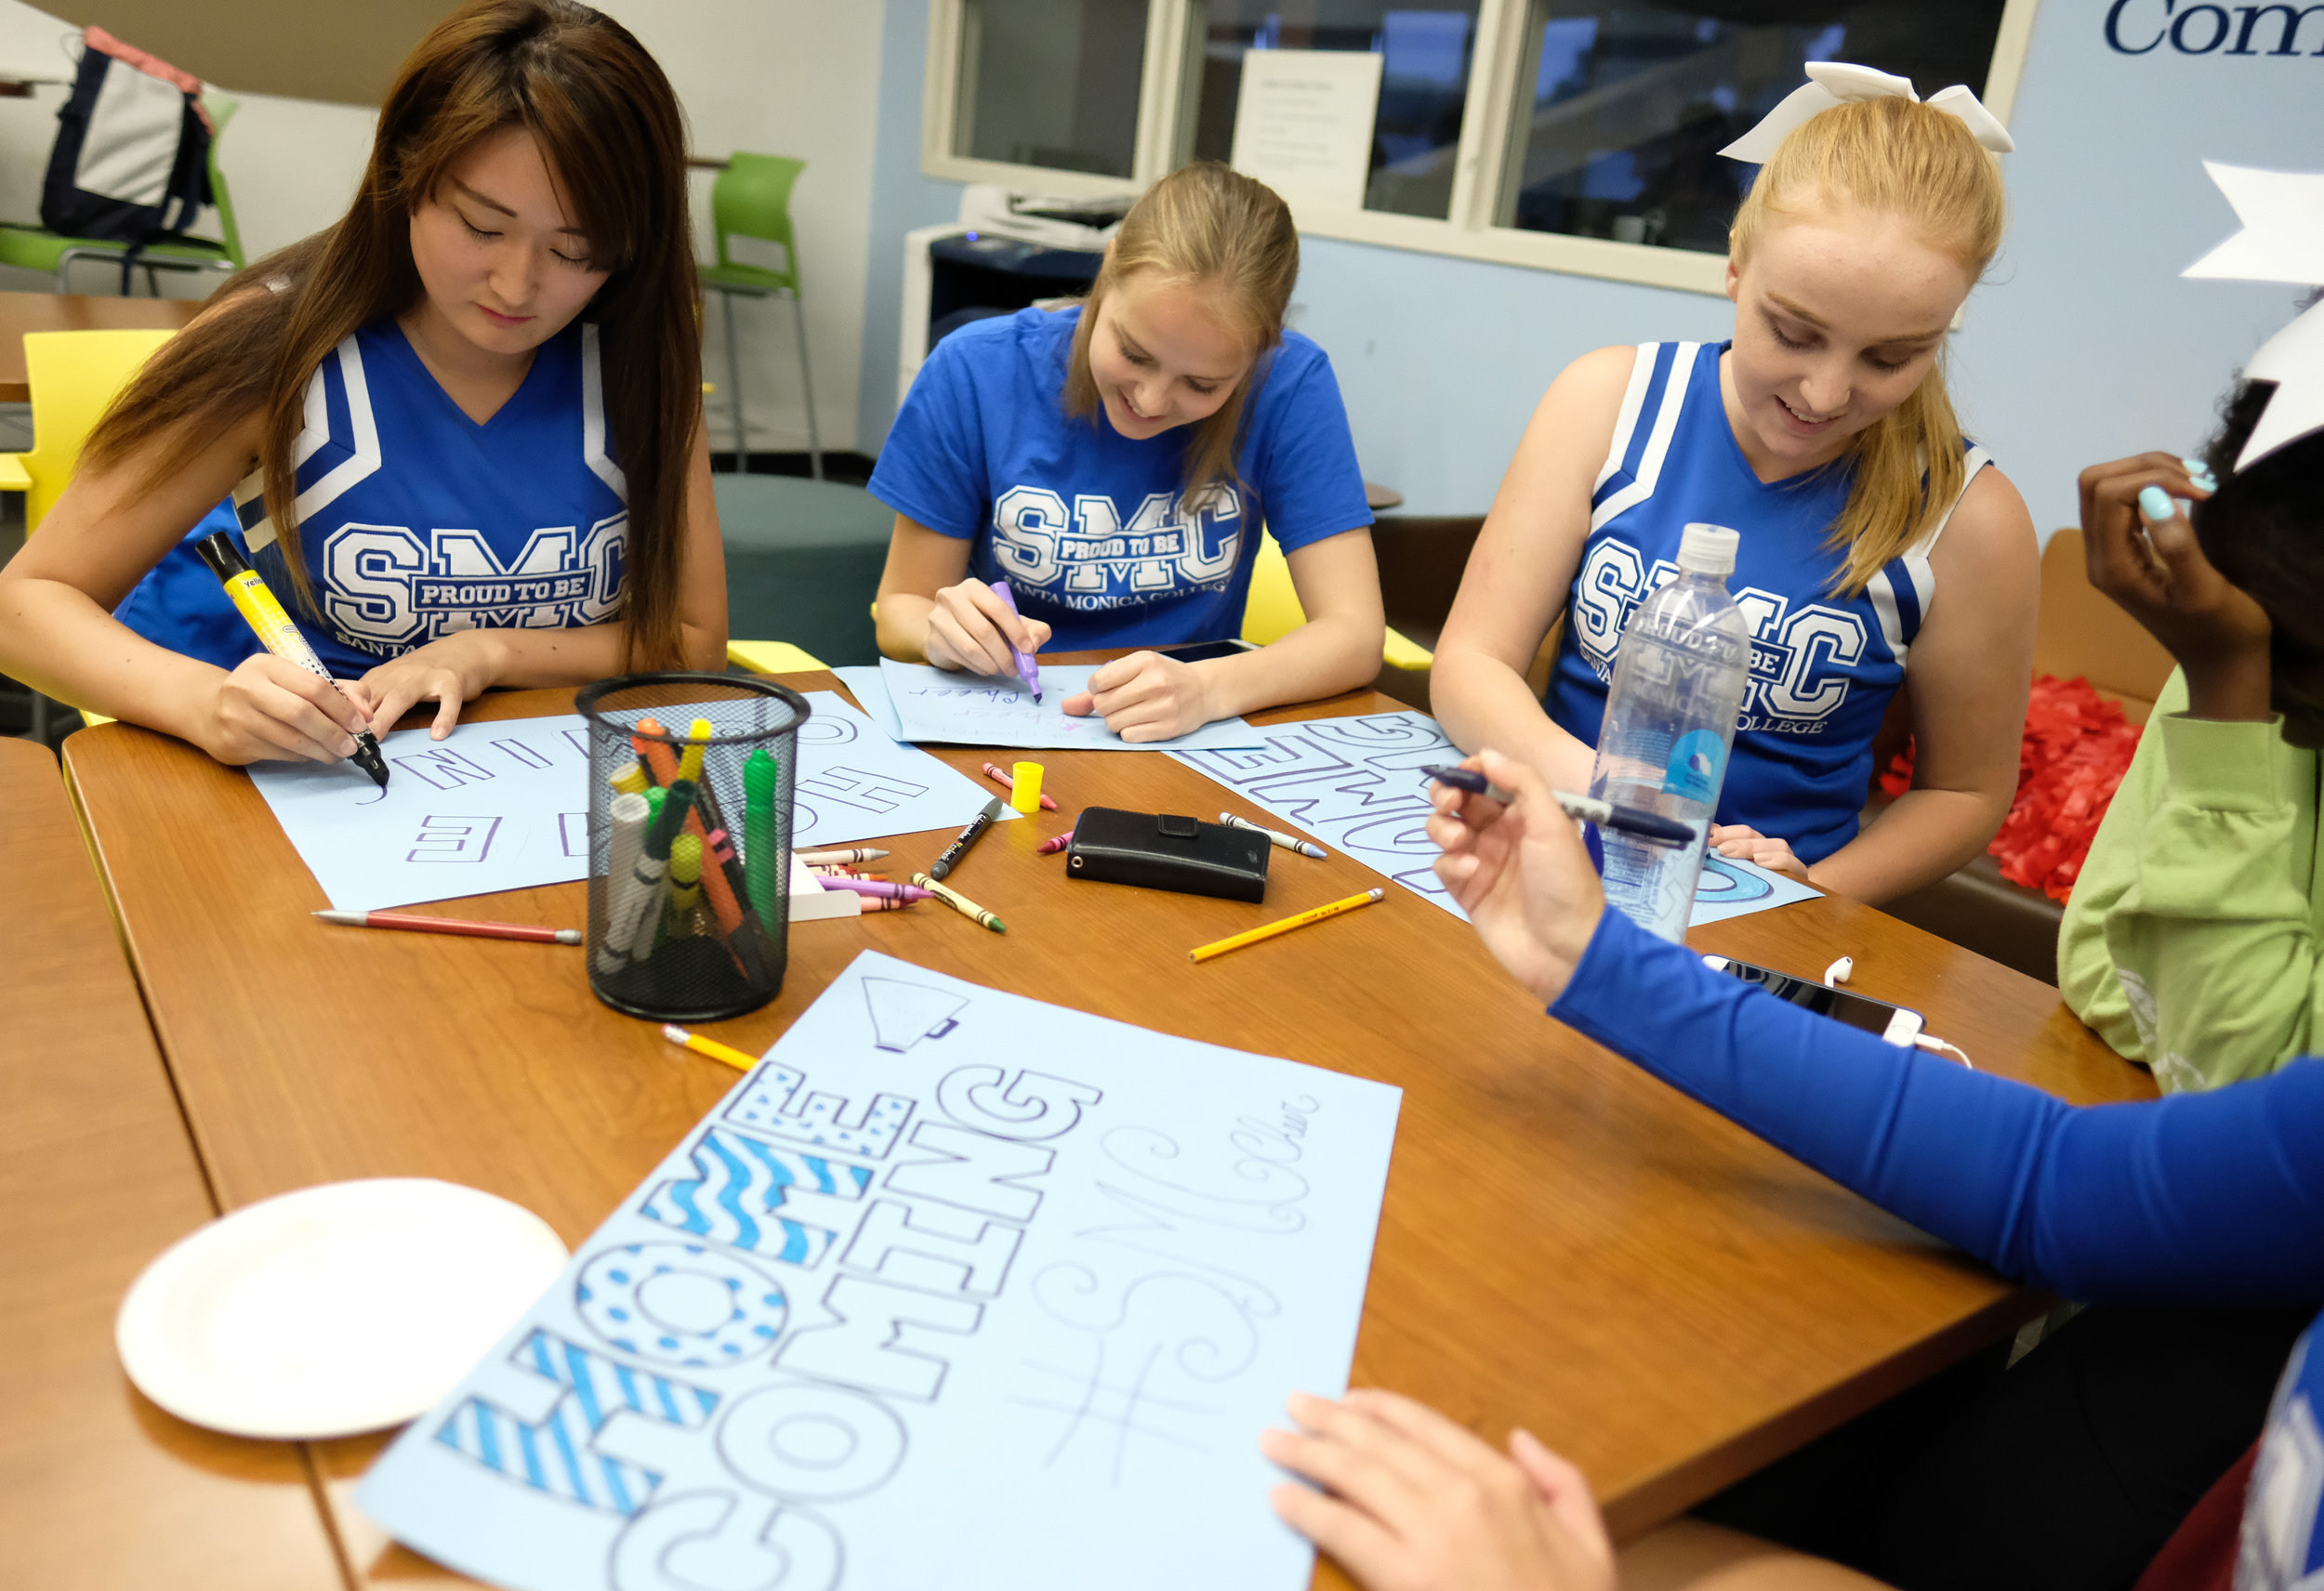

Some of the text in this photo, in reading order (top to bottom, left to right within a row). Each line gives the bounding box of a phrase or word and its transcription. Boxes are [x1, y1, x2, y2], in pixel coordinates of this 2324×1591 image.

[993, 483, 1241, 593] SMC
[1060, 533, 1181, 559] PROUD TO BE
[324, 509, 629, 644] SMC
[421, 576, 586, 604] PROUD TO BE
[1003, 574, 1061, 604] SANTA
[1064, 592, 1147, 611] MONICA
[335, 629, 424, 658] SANTA
[1574, 536, 1868, 721] SMC
[1749, 650, 1779, 676] BE
[431, 1060, 920, 1520] HOME
[608, 1063, 1104, 1591] COMING
